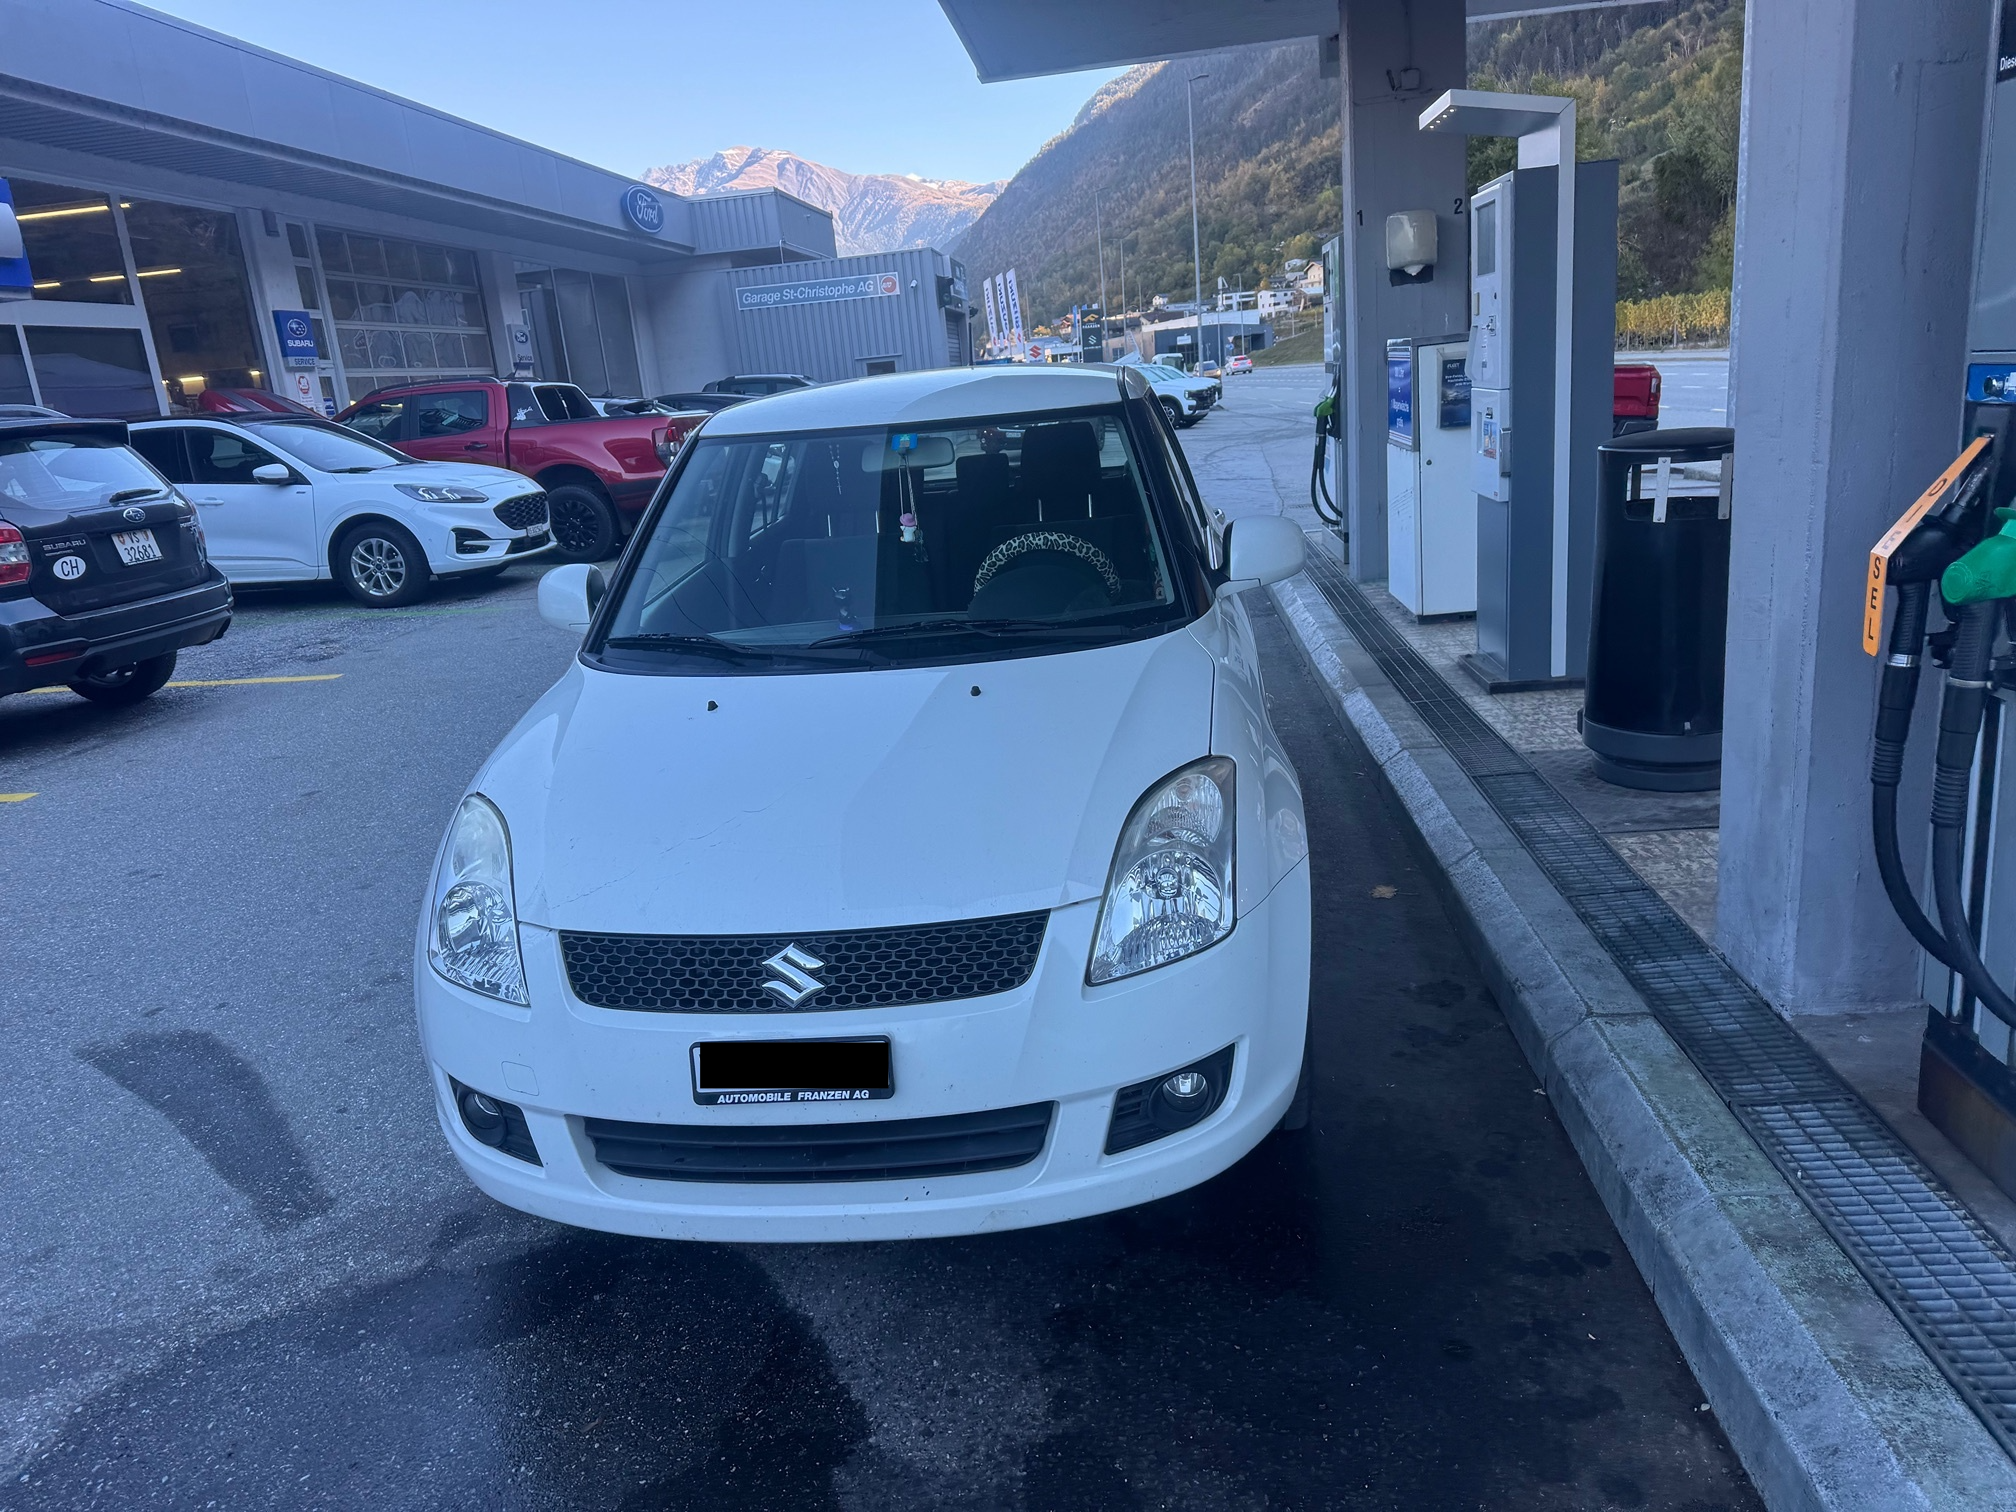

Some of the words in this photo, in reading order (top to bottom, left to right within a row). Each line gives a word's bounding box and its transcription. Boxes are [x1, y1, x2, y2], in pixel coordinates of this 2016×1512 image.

[2000, 56, 2016, 71] Dies
[636, 192, 659, 224] Ford
[1453, 197, 1464, 215] 2
[1356, 209, 1364, 226] 1
[742, 291, 781, 304] Garage
[782, 285, 855, 301] St-Christophe
[857, 280, 874, 293] AG
[287, 339, 314, 348] SUBARU
[294, 358, 316, 366] SERVICE
[42, 539, 87, 551] SUBARU
[126, 531, 141, 544] VS
[124, 543, 157, 562] 32681
[60, 560, 80, 577] CH
[717, 1092, 791, 1104] AUTOMOBILE
[797, 1090, 850, 1101] FRANZEN
[852, 1089, 869, 1100] AG
